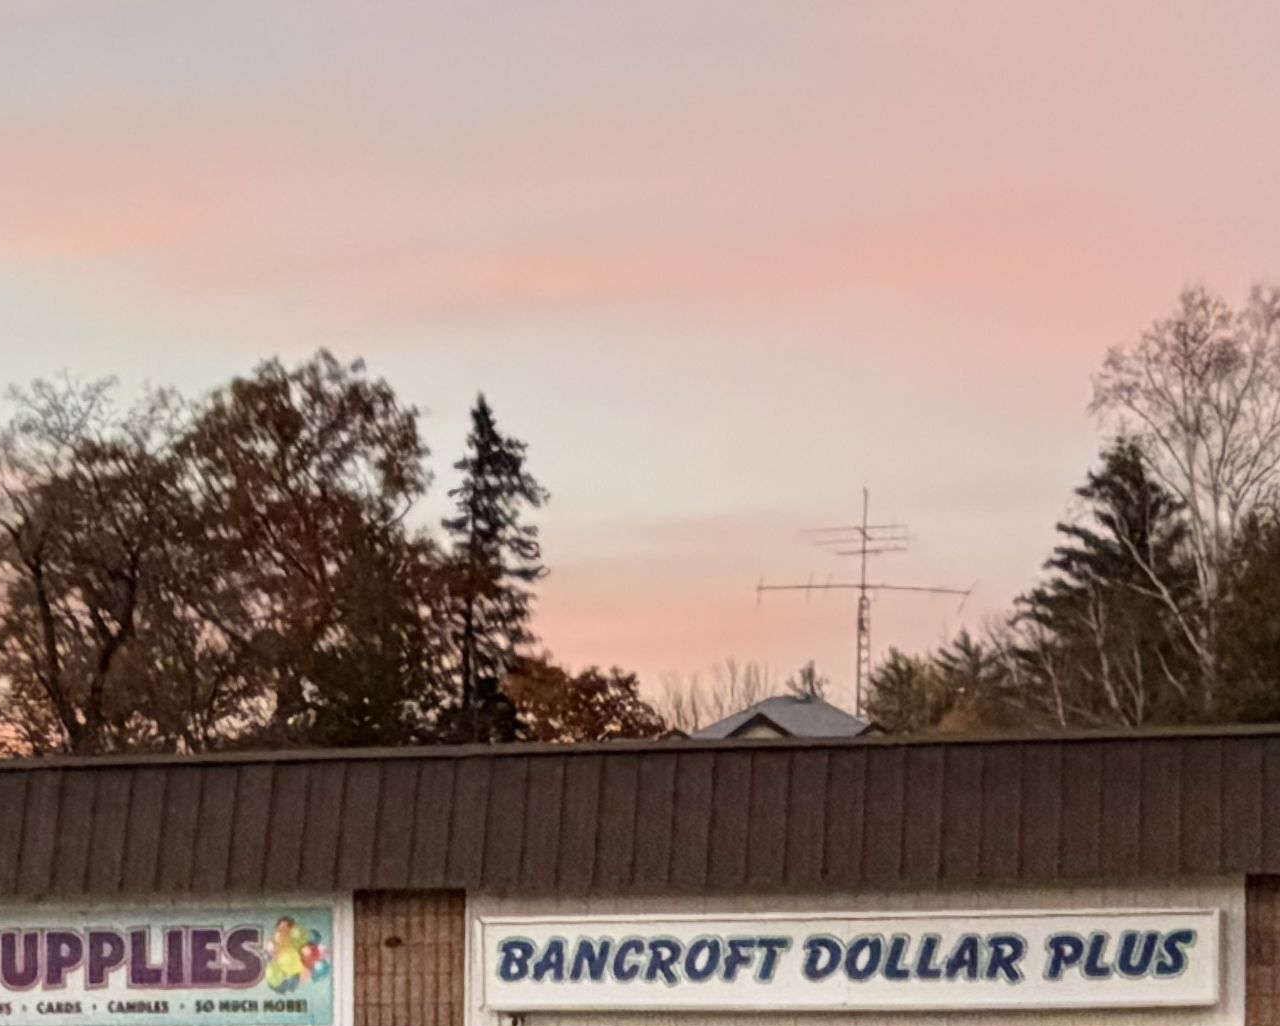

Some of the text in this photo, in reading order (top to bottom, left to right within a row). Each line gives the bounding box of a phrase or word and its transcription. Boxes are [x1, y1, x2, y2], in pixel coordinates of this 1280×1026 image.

[496, 928, 1196, 986] BANCROFT DOLLAR PLUS
[37, 1001, 83, 1014] CARDS
[107, 1000, 170, 1014] CANDLES
[195, 1000, 215, 1014] SO
[218, 1000, 258, 1014] MUCH
[262, 999, 308, 1014] MORE!
